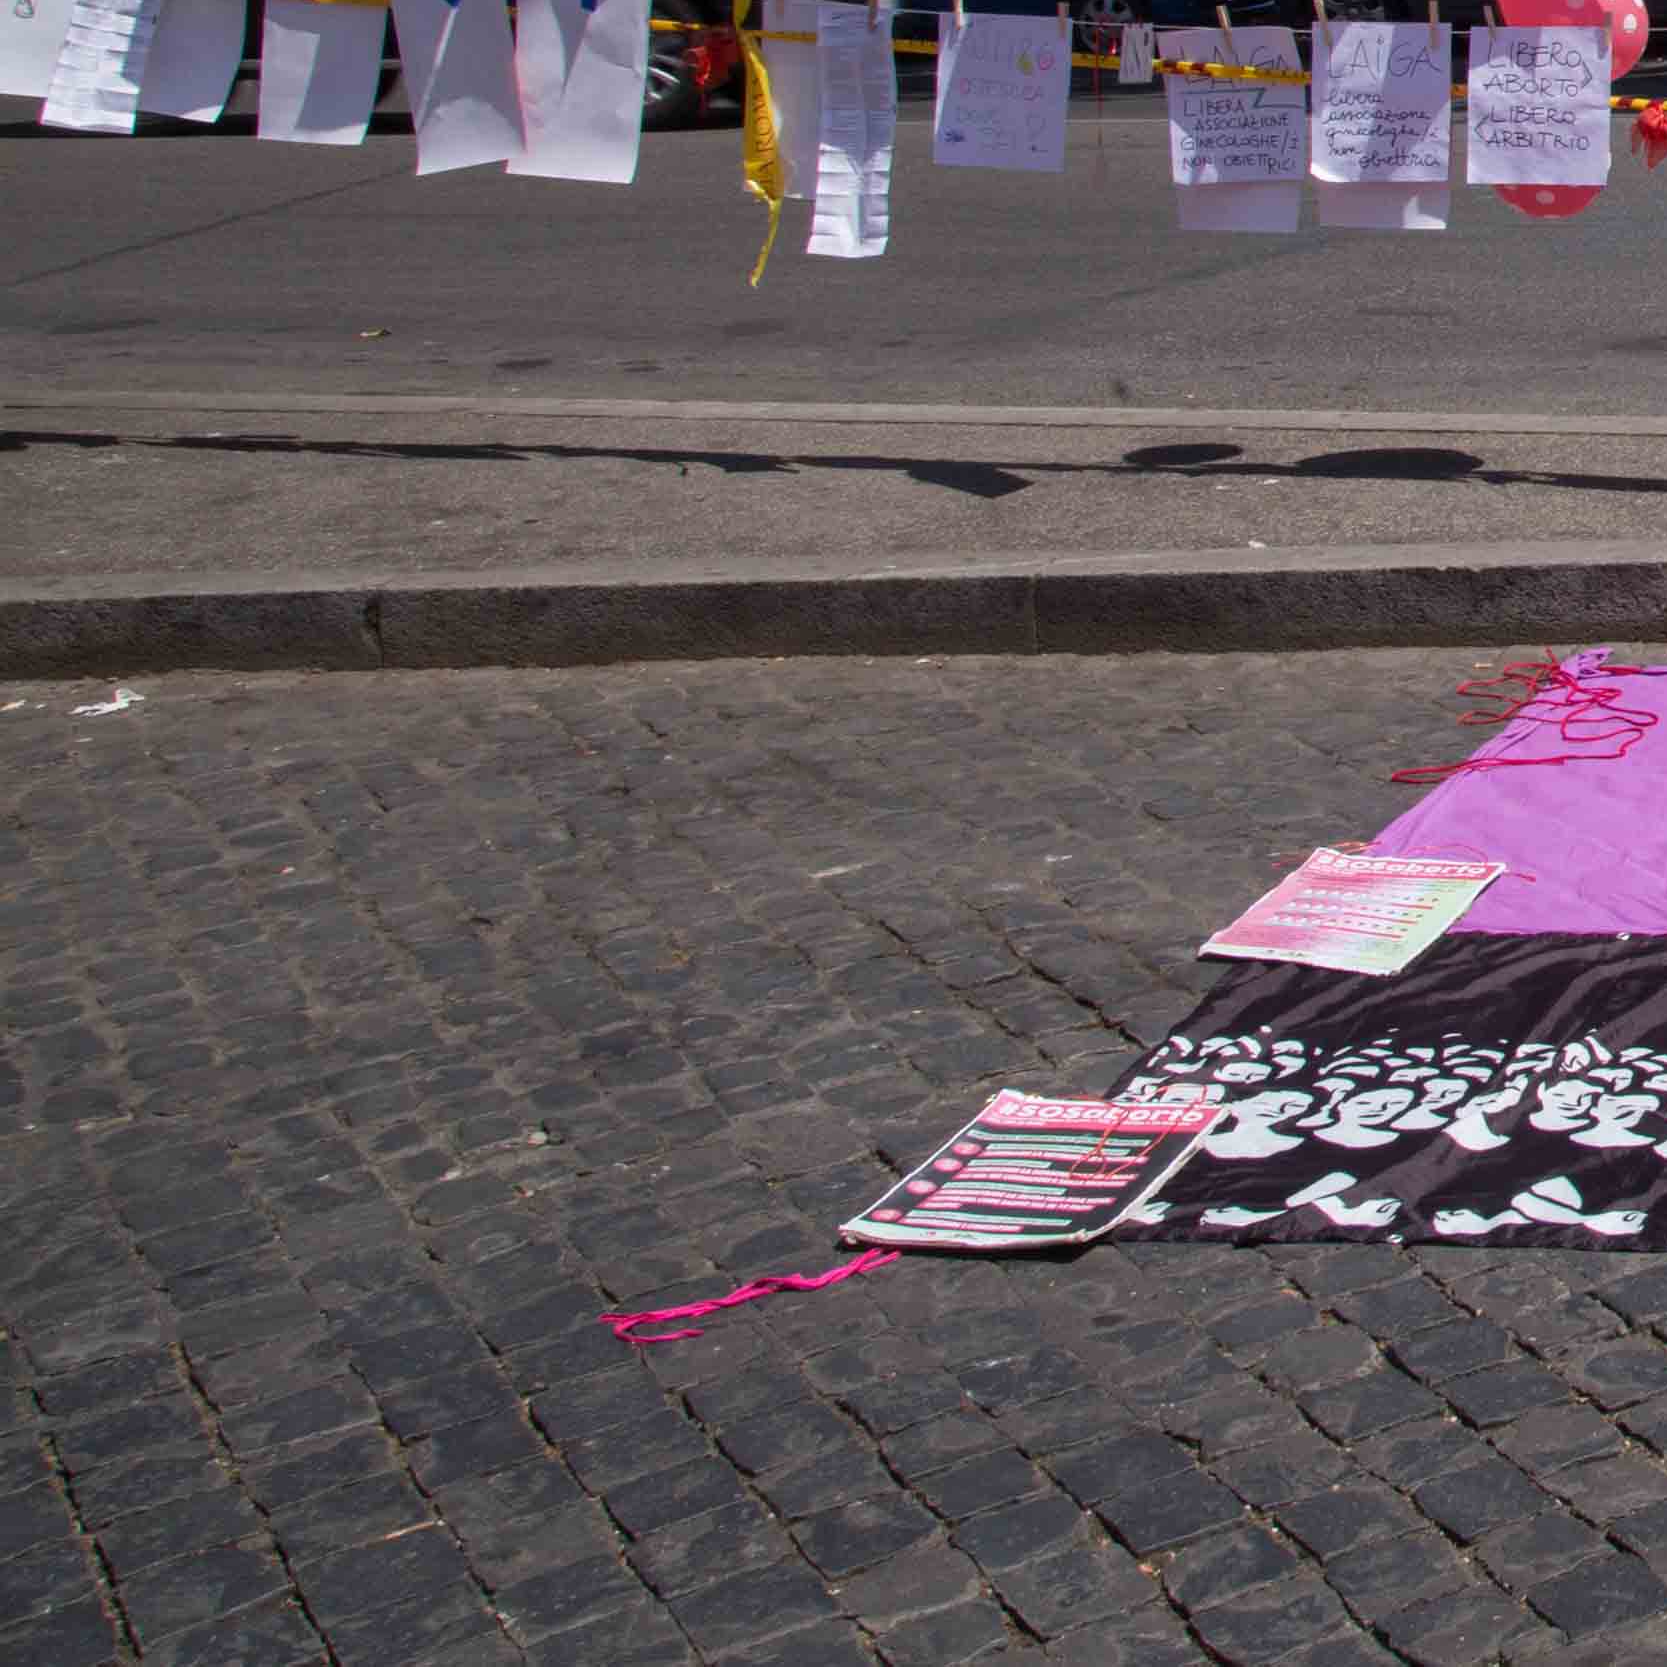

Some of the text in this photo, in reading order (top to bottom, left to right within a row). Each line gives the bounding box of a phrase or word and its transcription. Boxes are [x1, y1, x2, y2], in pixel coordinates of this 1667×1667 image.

[1488, 41, 1582, 69] LIBERO
[1483, 74, 1580, 98] ABORTO
[1488, 105, 1575, 125] LIBERO
